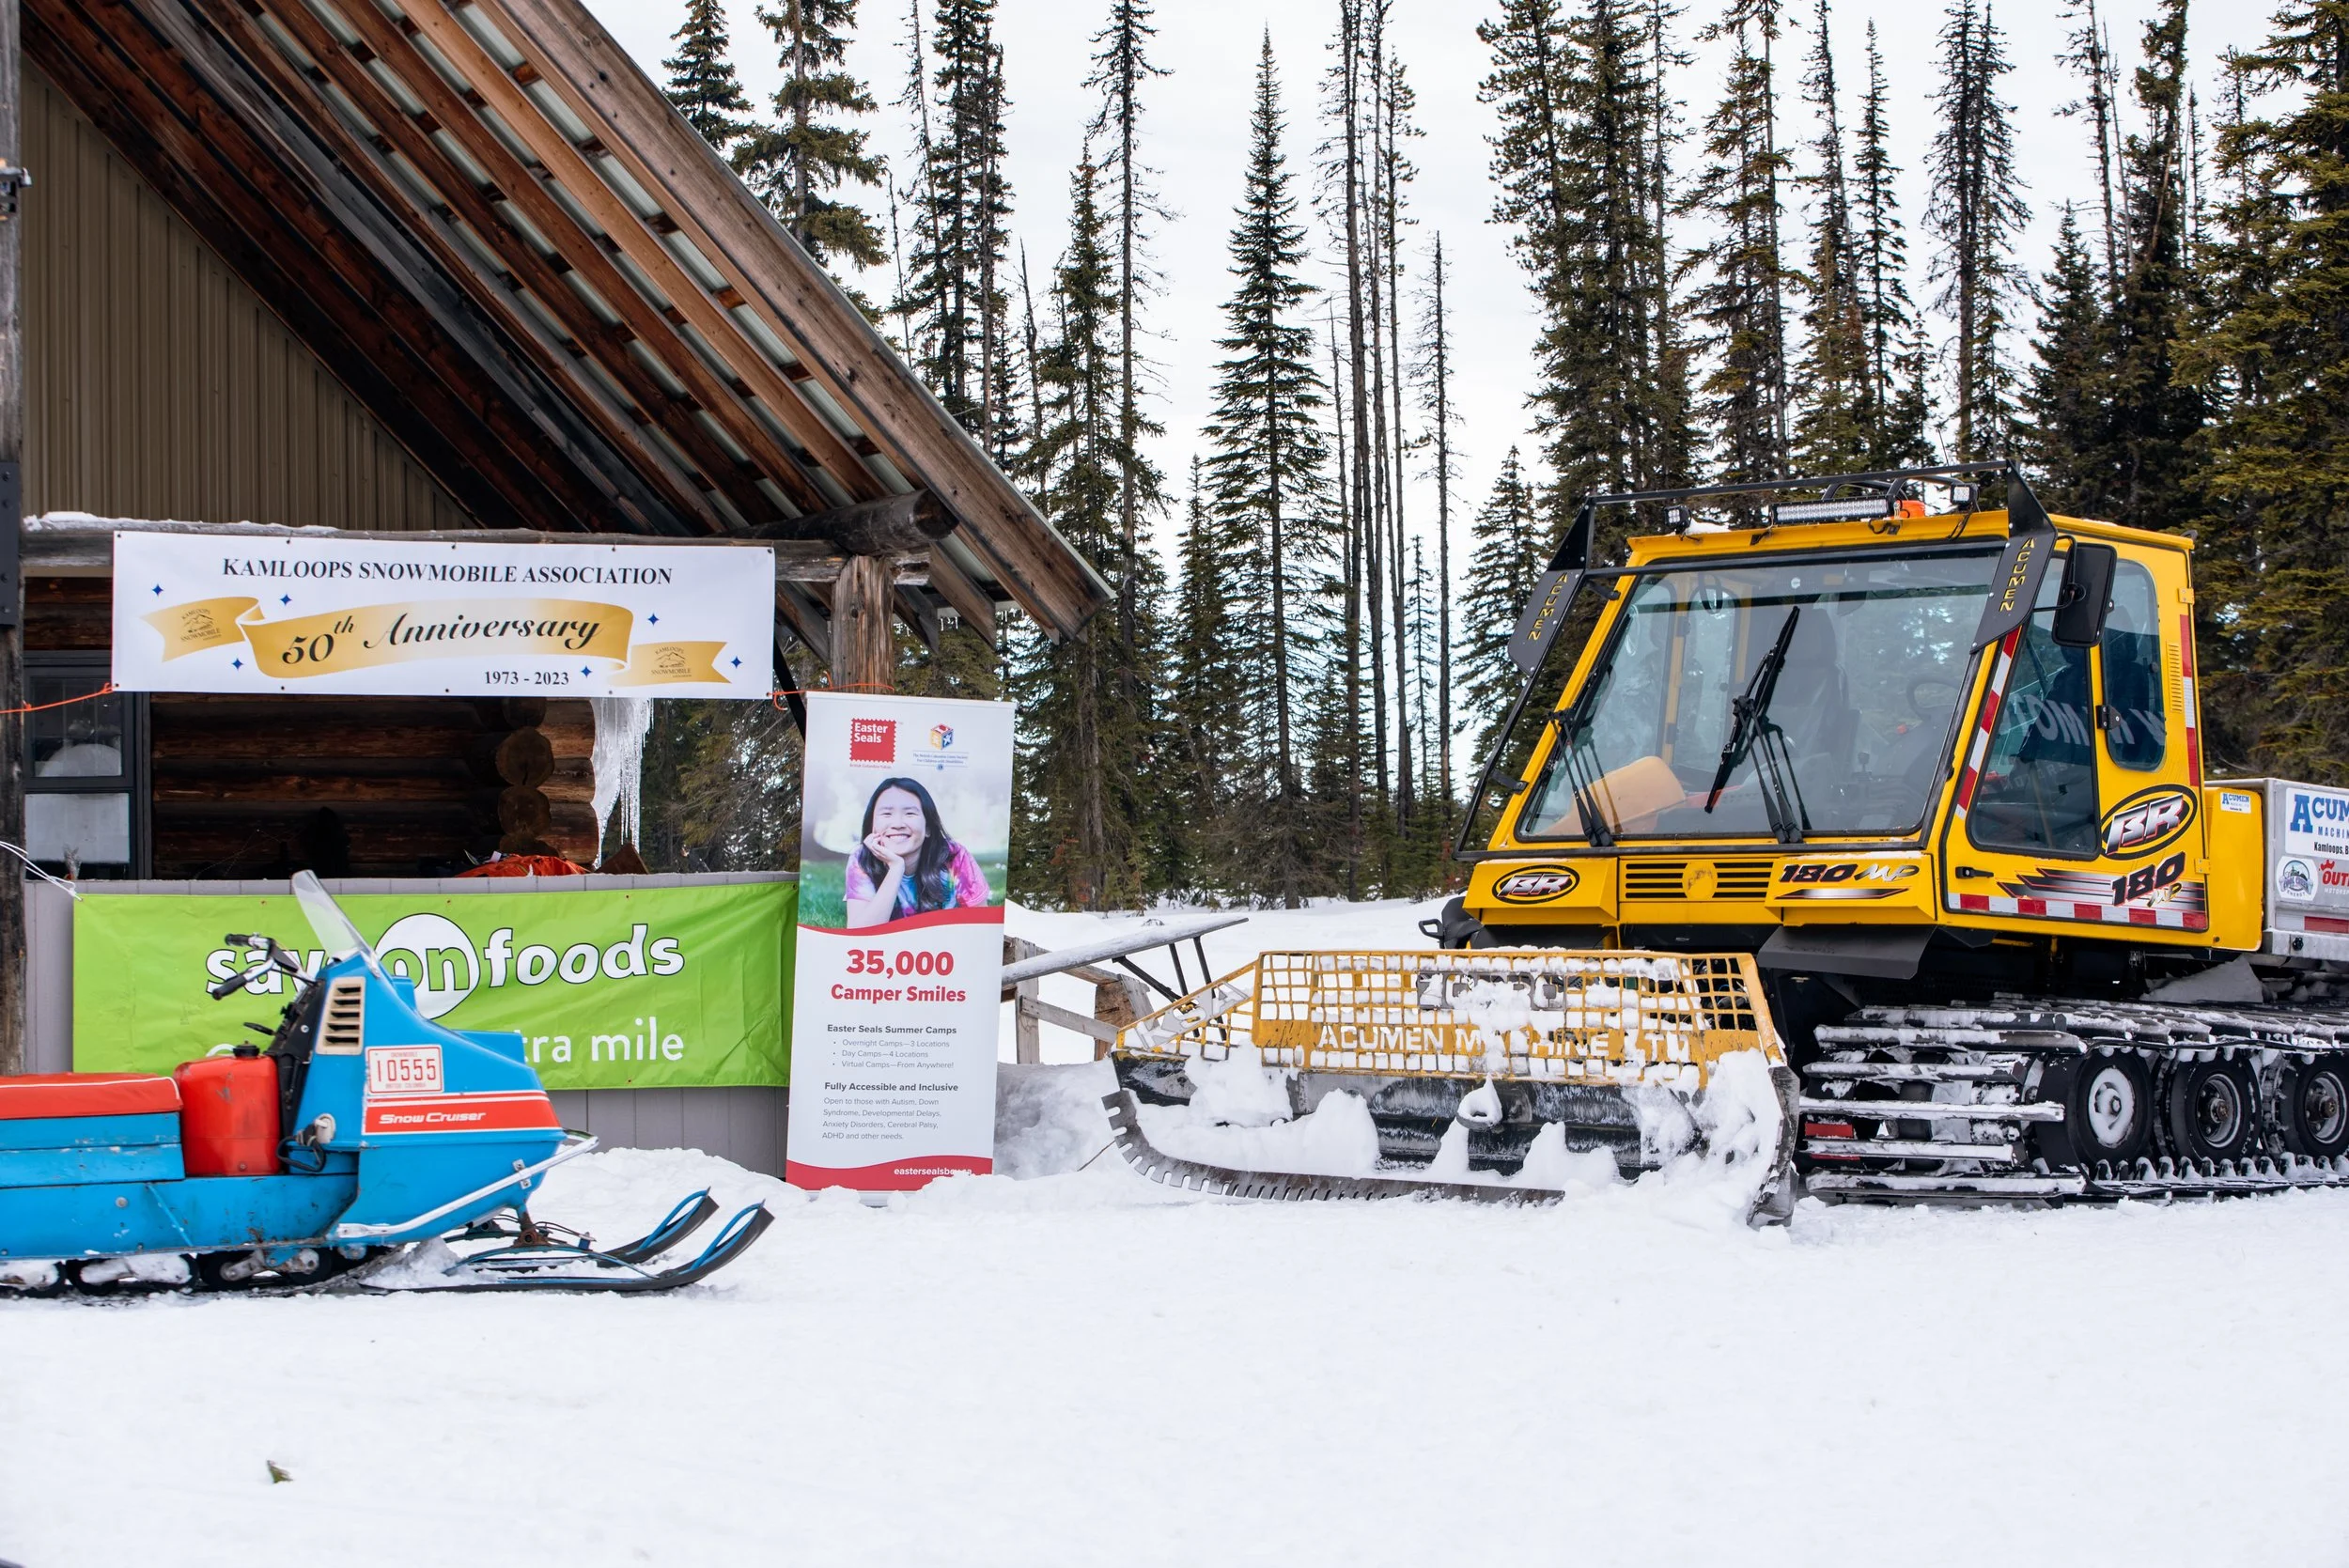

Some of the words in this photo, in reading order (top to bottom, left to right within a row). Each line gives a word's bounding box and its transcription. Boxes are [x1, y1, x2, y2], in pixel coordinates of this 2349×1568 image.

[224, 558, 352, 579] KAMLOOPS
[359, 562, 517, 582] SNOWMOBILE
[522, 566, 673, 584] ASSOCIATION
[1999, 537, 2035, 612] ACUMEN
[1528, 572, 1568, 640] ACUMEN
[283, 615, 357, 664] 50th
[364, 613, 603, 650] Anniversary
[655, 646, 684, 655] KAMLOOPS
[485, 671, 519, 685] 1973
[535, 672, 569, 686] 2023
[855, 722, 889, 734] Easter
[854, 733, 882, 743] Seals
[2106, 793, 2184, 855] BR
[2314, 842, 2343, 854] Kamloops,
[1780, 863, 1858, 882] 180
[2112, 851, 2186, 906] 180
[2323, 871, 2349, 887] OUT
[1497, 874, 1571, 897] BR
[206, 949, 331, 996] sav
[379, 948, 470, 991] on
[484, 924, 684, 987] foods
[847, 949, 954, 979] 35,000
[831, 984, 902, 1004] Camper
[907, 986, 966, 1001] Smiles
[828, 1024, 856, 1032] Easter
[859, 1025, 882, 1033] Seals
[885, 1026, 923, 1034] Summer
[926, 1026, 957, 1034] Camps
[592, 1017, 684, 1062] mile
[843, 1039, 877, 1048] Overnight
[1317, 1026, 1443, 1051] ACUMEN
[1455, 1029, 1610, 1057] MHINE
[378, 1059, 436, 1082] 10555
[825, 1082, 847, 1092] Fully
[849, 1082, 896, 1092] Accessible
[899, 1083, 916, 1092] and
[919, 1083, 958, 1092] Inclusive
[824, 1097, 843, 1106] Open
[380, 1114, 424, 1125] Snow
[426, 1112, 486, 1123] Cruiser
[863, 1110, 914, 1118] Developmental
[917, 1110, 941, 1118] Delays,
[823, 1121, 848, 1129] Anxiety
[919, 1121, 939, 1130] Palsy,
